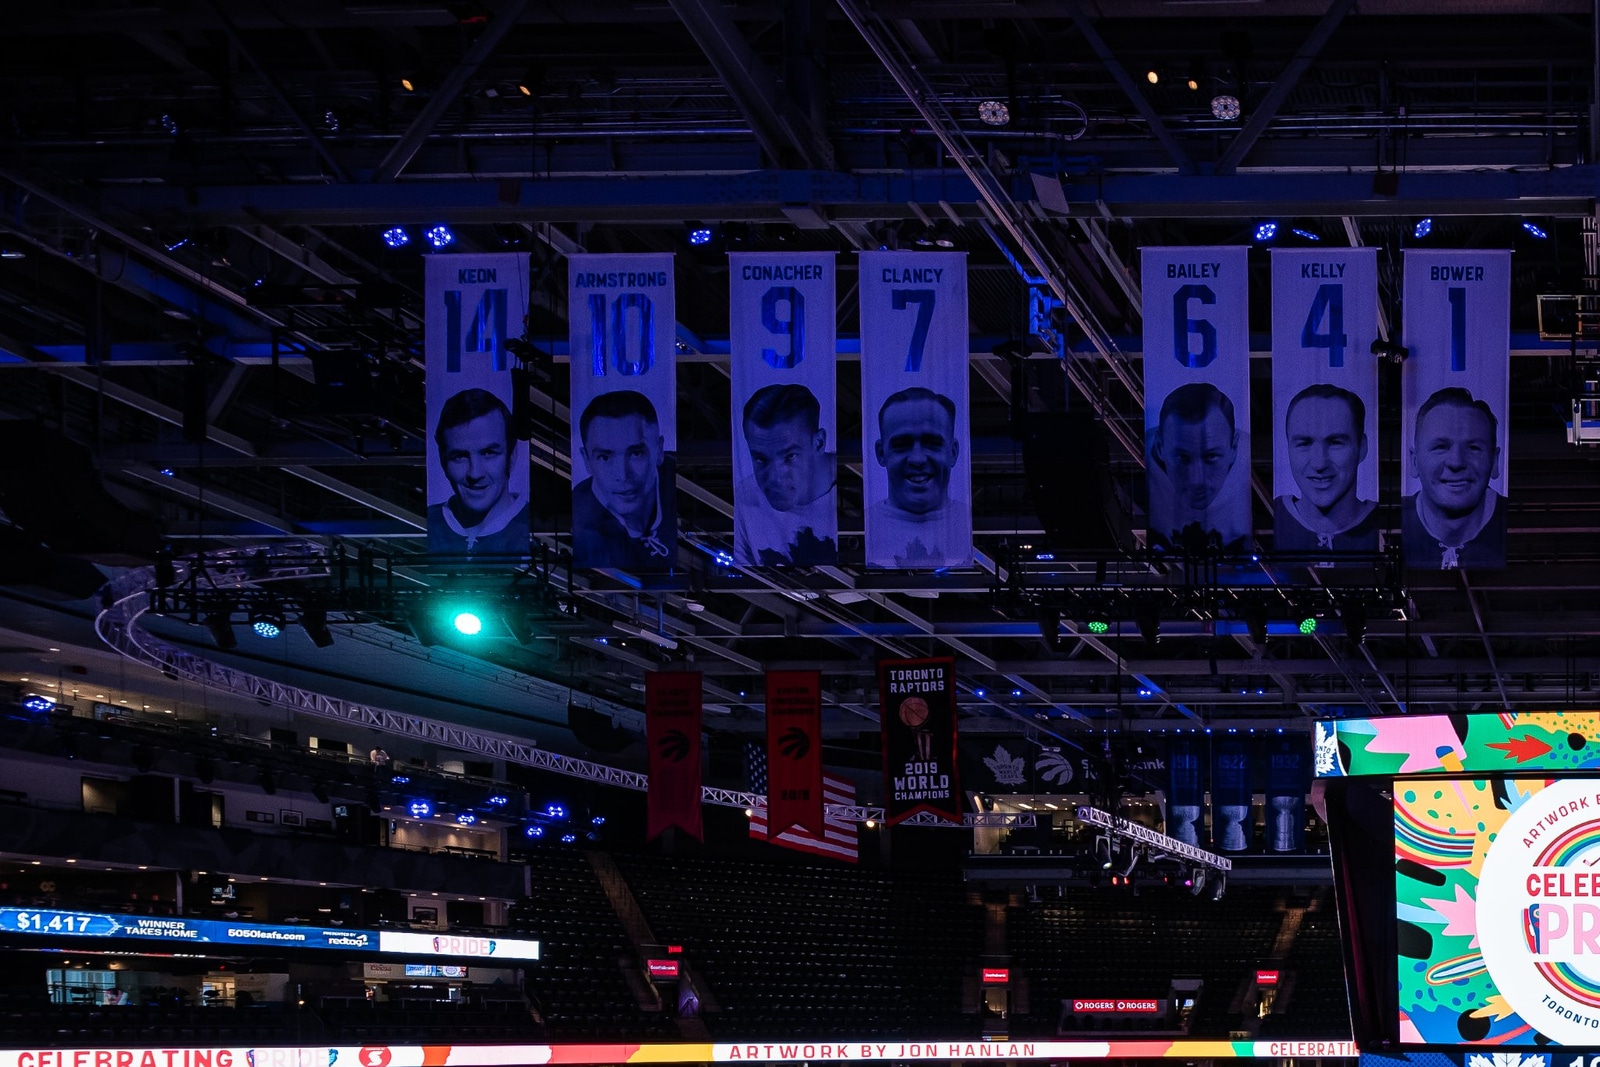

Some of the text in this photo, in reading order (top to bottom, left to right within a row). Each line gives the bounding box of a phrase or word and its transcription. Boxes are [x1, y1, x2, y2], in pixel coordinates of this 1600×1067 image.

[458, 268, 496, 285] KEON
[575, 270, 667, 288] ARMSTRONG
[742, 264, 823, 282] CONACHER
[882, 268, 943, 285] CLANCY
[1167, 263, 1221, 279] BAILEY
[1301, 263, 1346, 278] KELLY
[1430, 266, 1484, 282] BOWER
[443, 289, 508, 373] 14
[761, 286, 805, 369] 9
[891, 289, 937, 372] 7
[1173, 284, 1217, 368] 6
[1301, 283, 1347, 367] 4
[1447, 287, 1466, 371] 1
[588, 292, 655, 377] 10
[890, 668, 944, 681] TORONTO
[890, 680, 945, 693] RAPTORS
[904, 762, 938, 775] 2019
[894, 775, 950, 791] WORLD
[894, 788, 950, 801] CHAMPIONS
[1523, 796, 1590, 849] ARTWORK
[16, 912, 91, 933] $1,417
[137, 919, 186, 930] WINNER
[125, 926, 198, 938] TAKES HOME
[227, 929, 306, 942] 5050leafs.com
[438, 937, 489, 956] PRIDE
[1084, 1001, 1114, 1009] ROGERS
[1126, 1001, 1156, 1009] ROGERS
[1542, 994, 1600, 1030] TORONTO
[729, 1042, 1035, 1060] ARTWORK BY JON HANLAN
